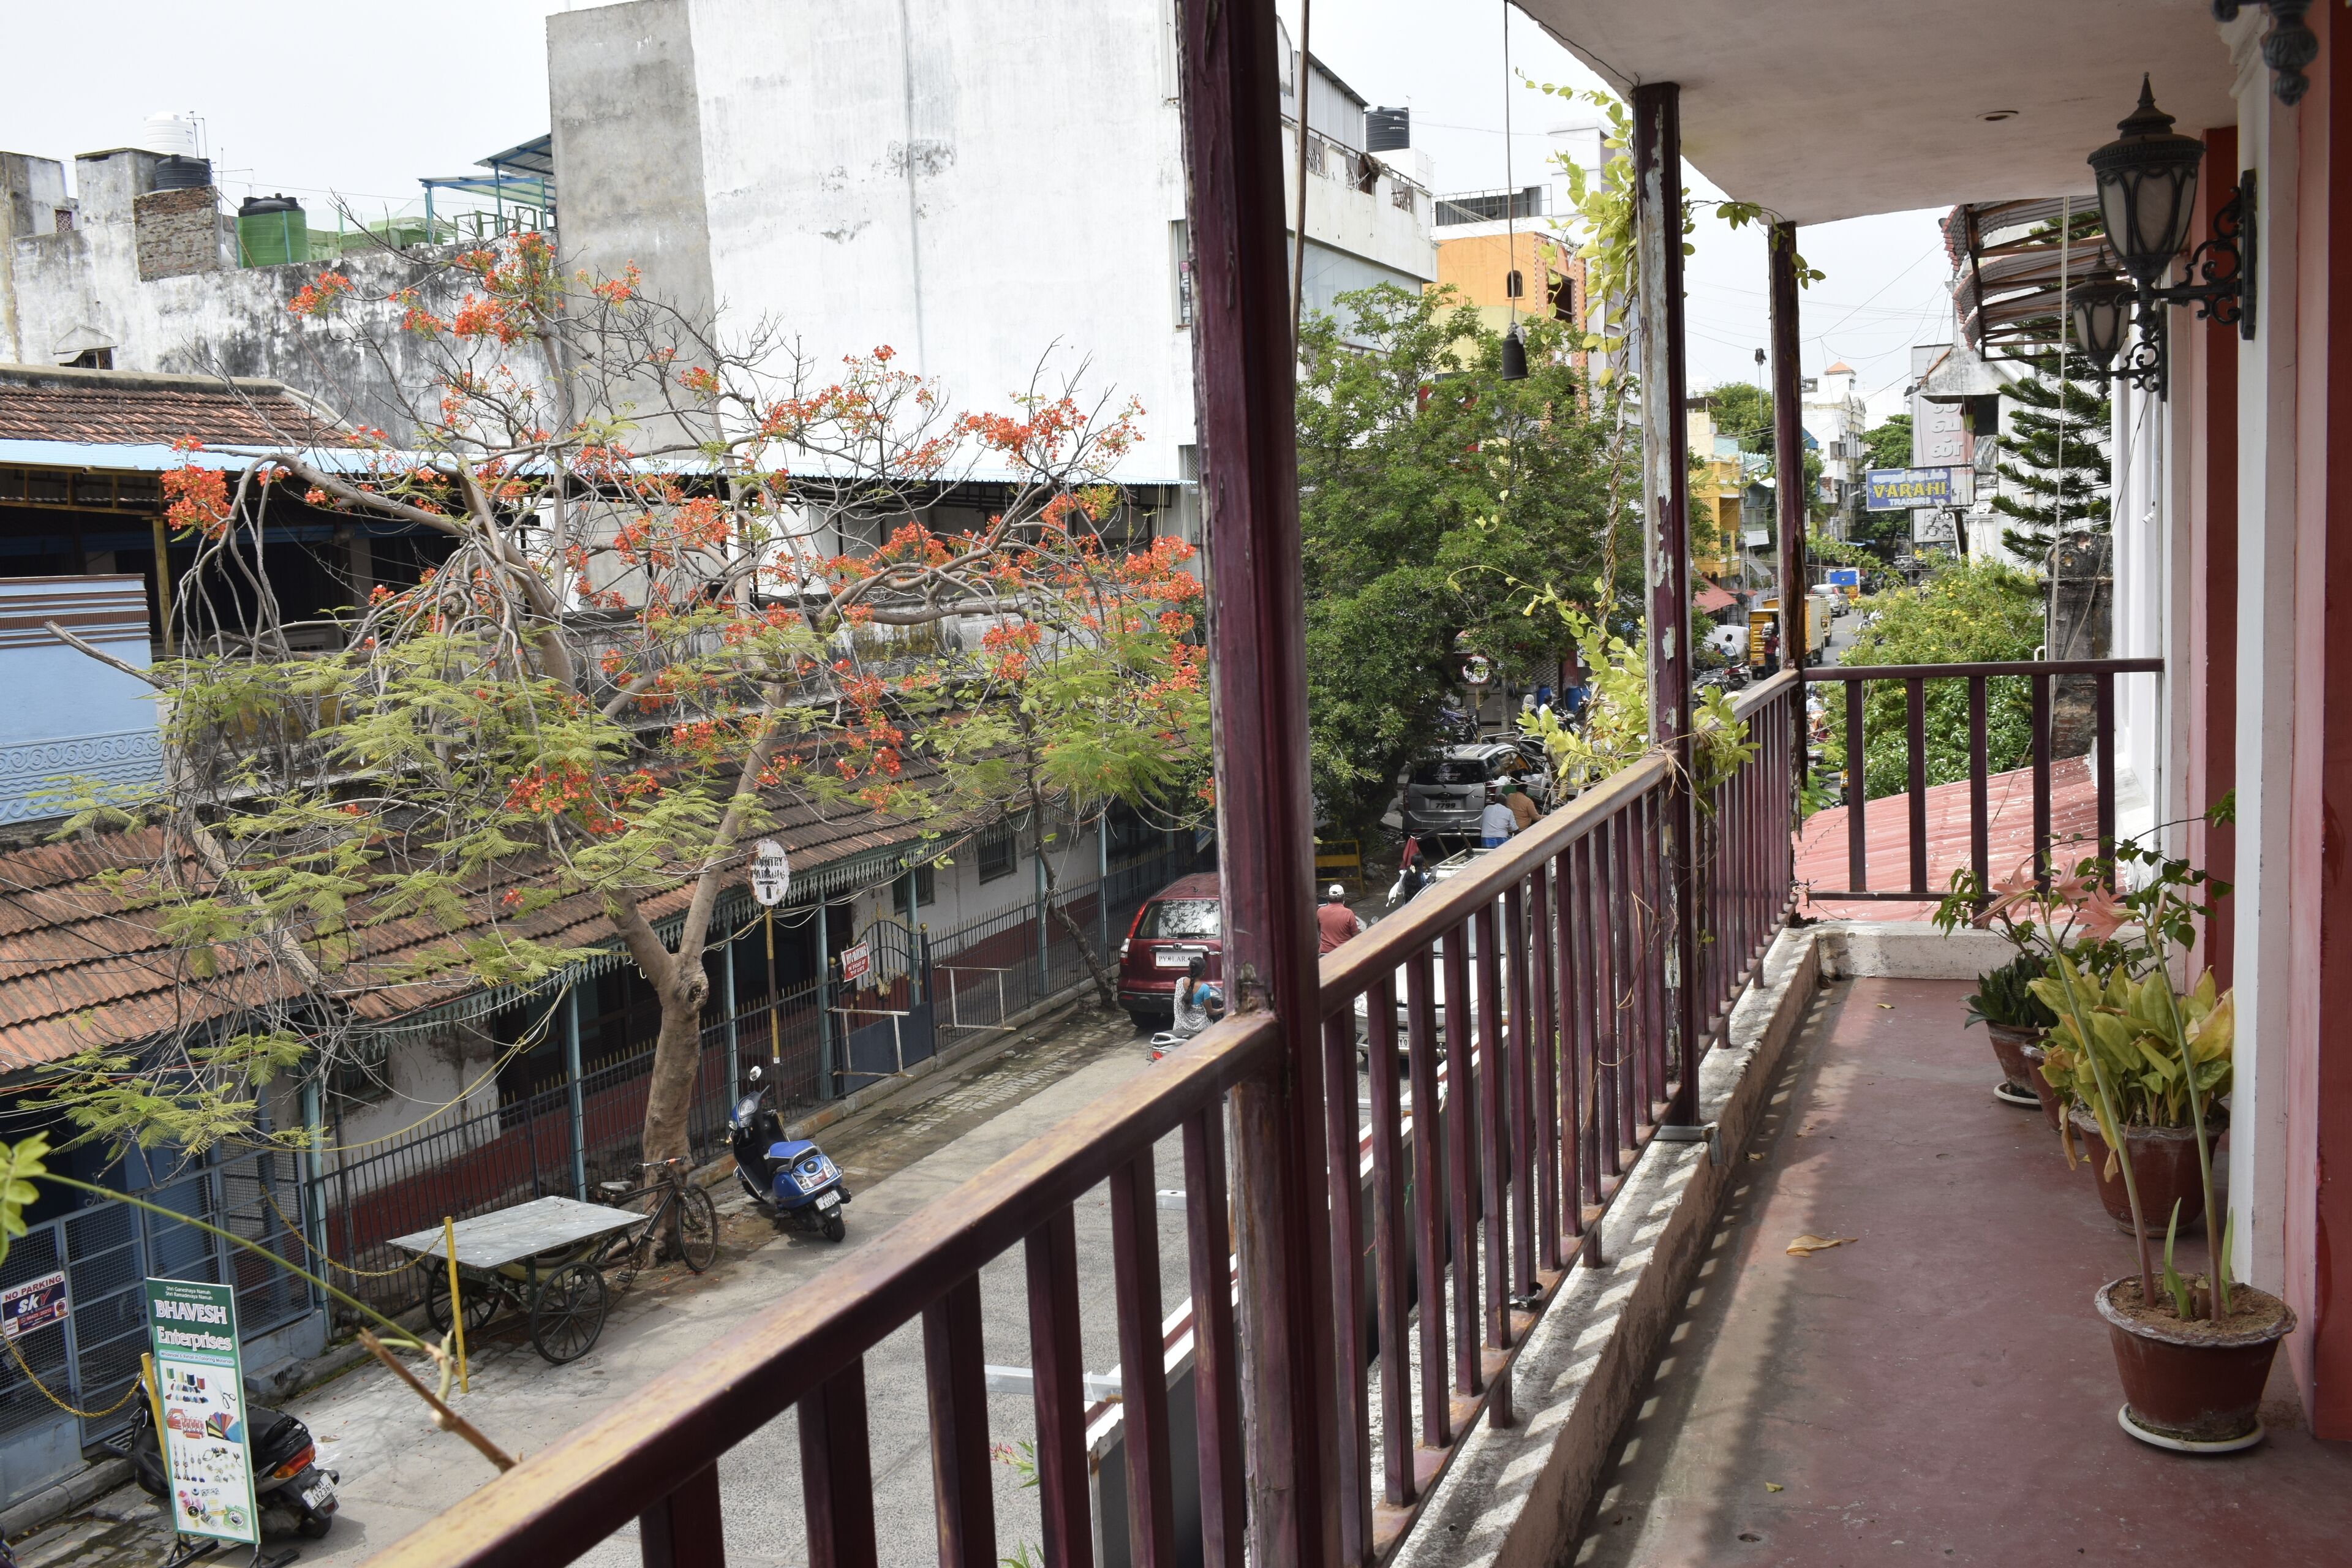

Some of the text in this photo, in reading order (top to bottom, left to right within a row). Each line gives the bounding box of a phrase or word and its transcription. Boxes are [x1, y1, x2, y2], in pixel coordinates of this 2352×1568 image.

[1872, 481, 1946, 498] VARAHI
[1888, 497, 1931, 506] TRADERS
[750, 870, 785, 879] PARING
[846, 945, 867, 965] NO PARKING
[5, 1275, 61, 1301] NO PARKING
[154, 1299, 227, 1324] BHAVESH
[156, 1326, 233, 1351] Enterprises
